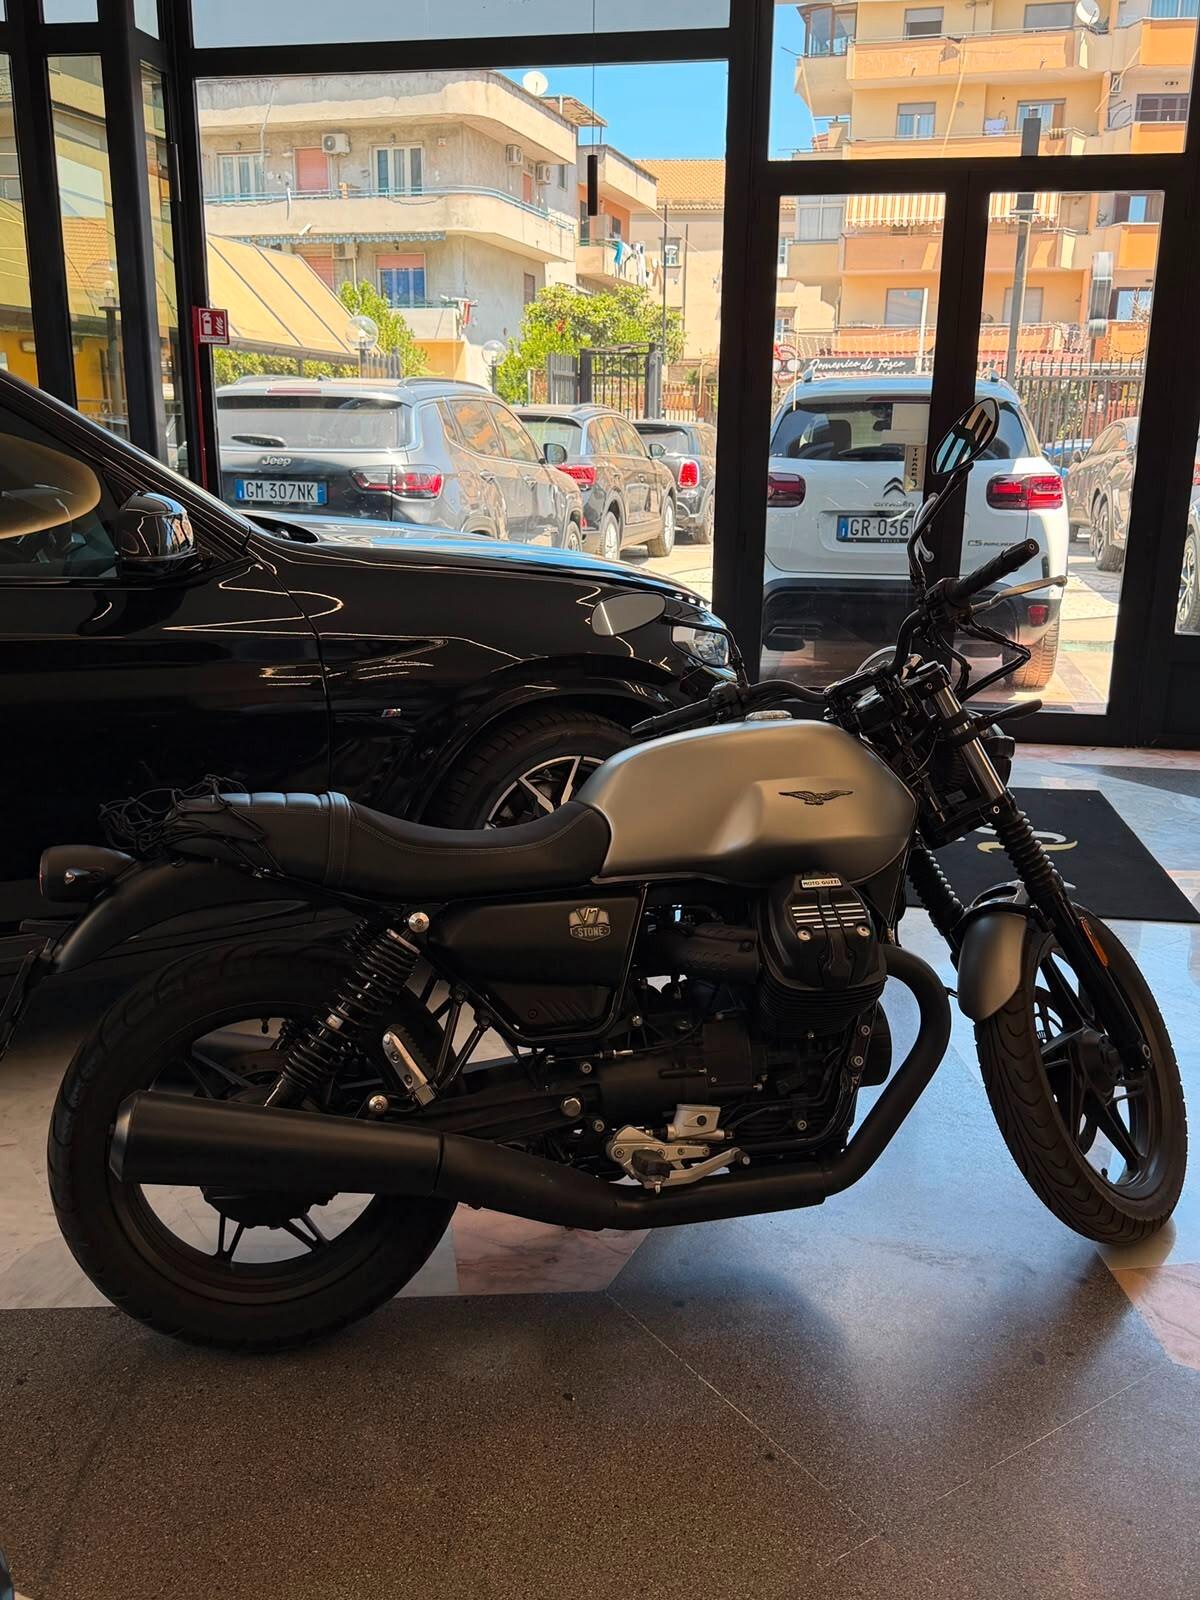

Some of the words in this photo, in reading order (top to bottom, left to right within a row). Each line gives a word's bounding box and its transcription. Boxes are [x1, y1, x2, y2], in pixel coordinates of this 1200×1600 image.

[262, 455, 292, 467] Jeep
[246, 482, 264, 499] GM
[269, 482, 315, 501] 307NK
[878, 519, 910, 536] 036
[575, 906, 600, 925] V7
[578, 926, 605, 937] STONE
